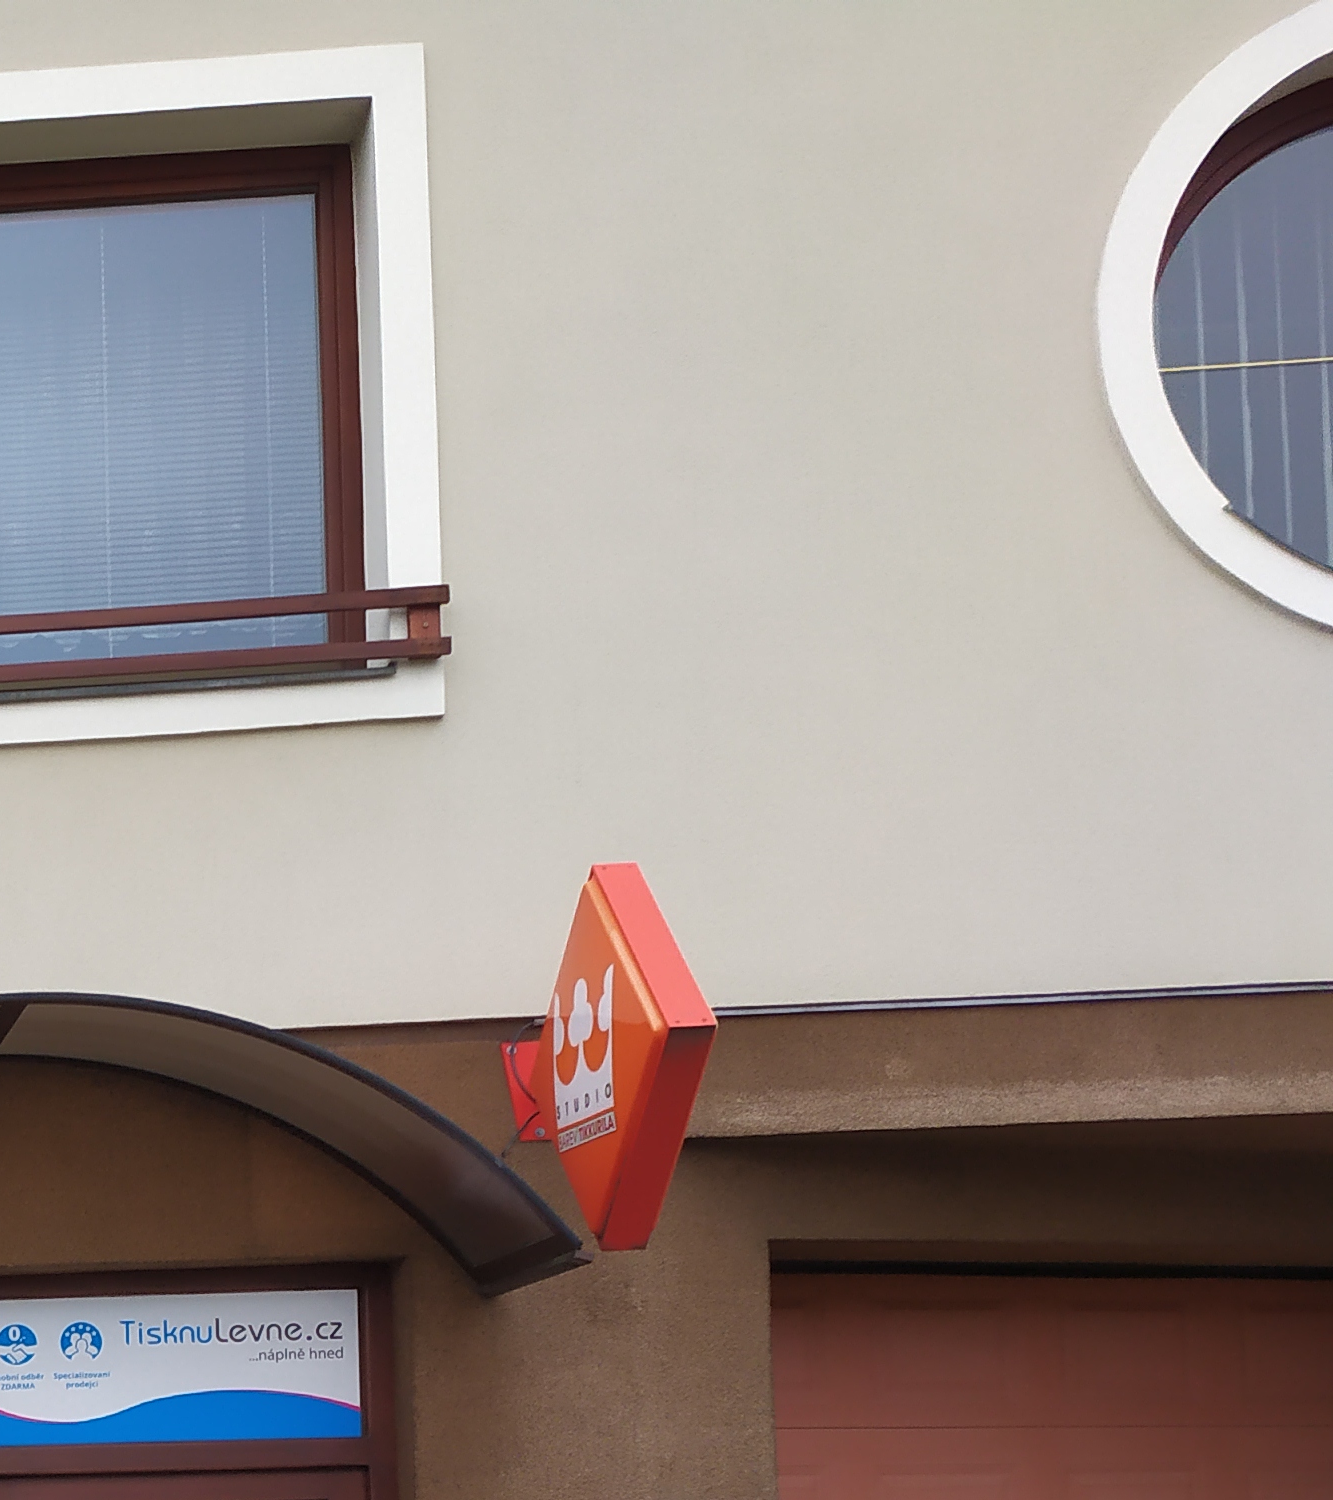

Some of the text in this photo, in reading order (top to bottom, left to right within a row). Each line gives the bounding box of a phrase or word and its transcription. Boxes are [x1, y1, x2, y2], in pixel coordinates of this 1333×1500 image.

[557, 1083, 611, 1120] STUDIO
[119, 1318, 343, 1346] TisknuLevne.cz
[309, 1347, 344, 1359] hned
[66, 1381, 98, 1389] prodejci
